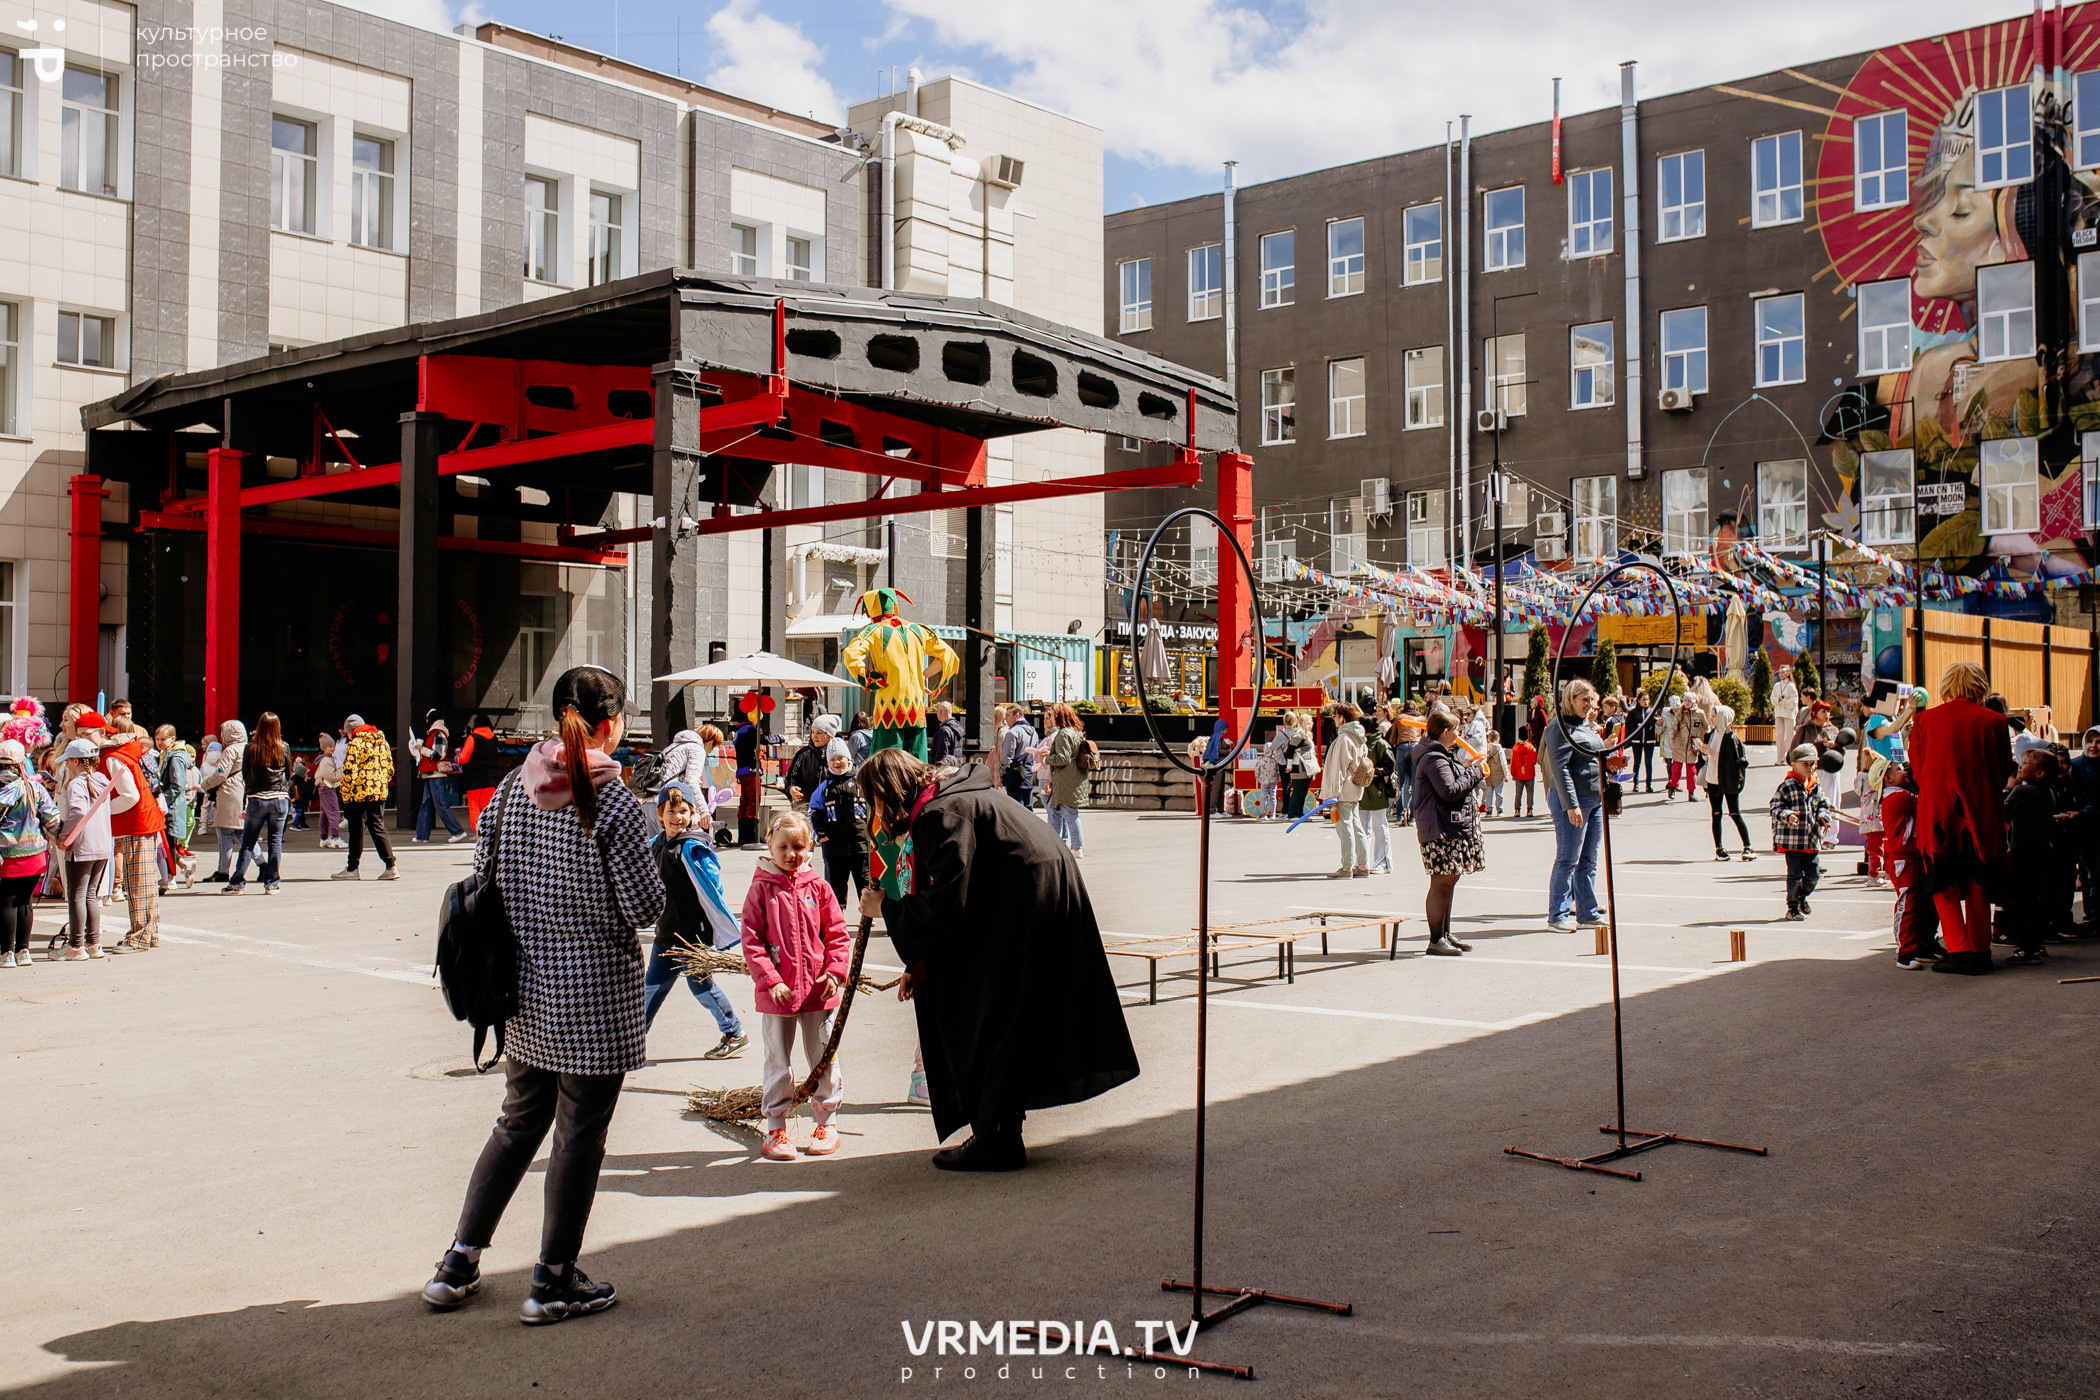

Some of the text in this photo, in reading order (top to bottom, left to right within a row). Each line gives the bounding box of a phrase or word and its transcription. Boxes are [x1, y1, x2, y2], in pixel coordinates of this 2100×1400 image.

[1918, 484, 1964, 496] MAN ON THE
[1941, 493, 1964, 503] MOON
[1117, 622, 1219, 640] ПИО ДА ЗАКУСК
[329, 596, 356, 687] культурное
[455, 599, 483, 689] пространство
[1026, 671, 1037, 679] CO
